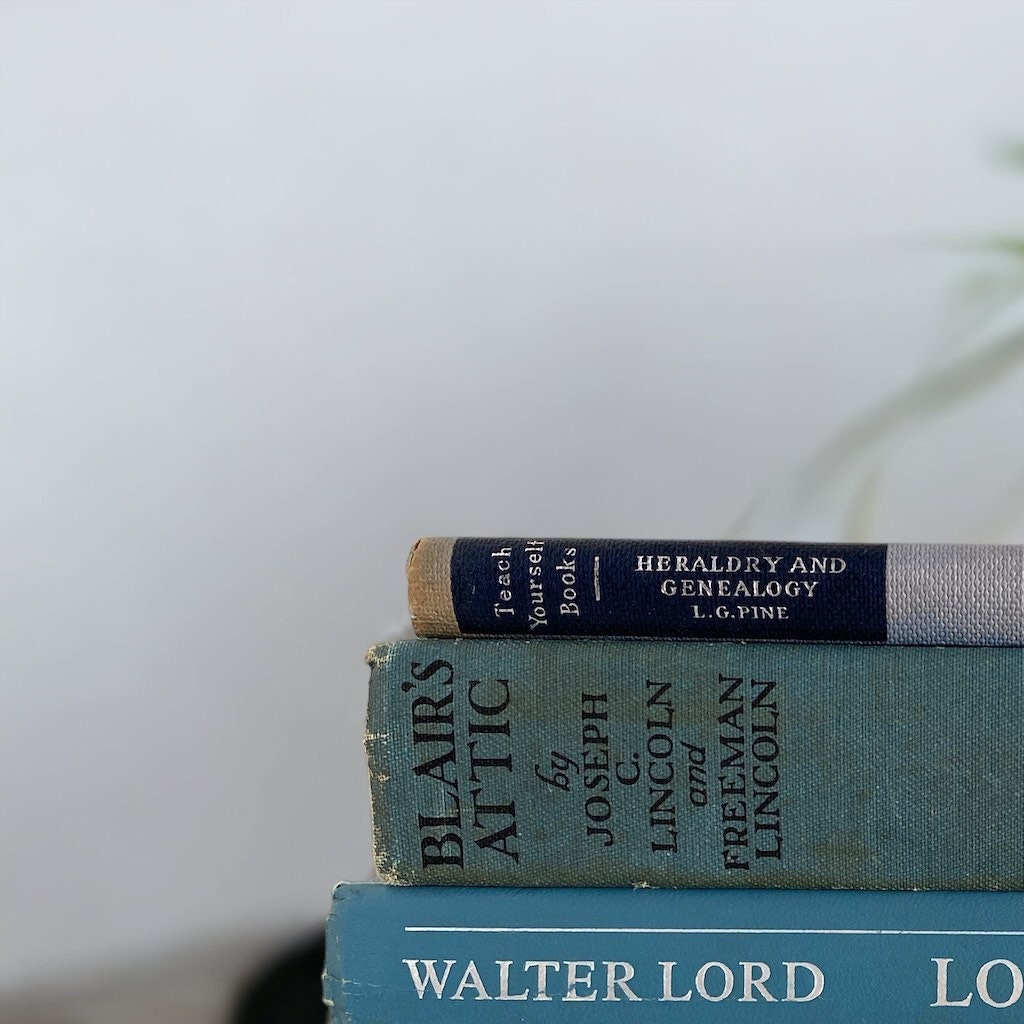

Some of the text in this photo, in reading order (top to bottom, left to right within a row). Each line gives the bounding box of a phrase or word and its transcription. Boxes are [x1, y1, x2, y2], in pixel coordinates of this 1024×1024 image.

[491, 547, 515, 617] Teach
[525, 540, 548, 630] Yourself
[556, 547, 580, 616] Books
[634, 555, 848, 574] HERALDRY AND
[660, 579, 820, 598] GENEALOGY
[401, 658, 464, 869] BLAIR'S
[467, 678, 520, 863] ATTIC
[535, 751, 580, 792] by
[582, 692, 615, 847] JOSEPH
[615, 752, 642, 786] C.
[646, 679, 679, 853] LINCOLN
[681, 743, 709, 807] and
[718, 673, 751, 871] FREEMAN
[751, 679, 783, 861] LINCOLN
[402, 959, 826, 1003] WALTER LORD
